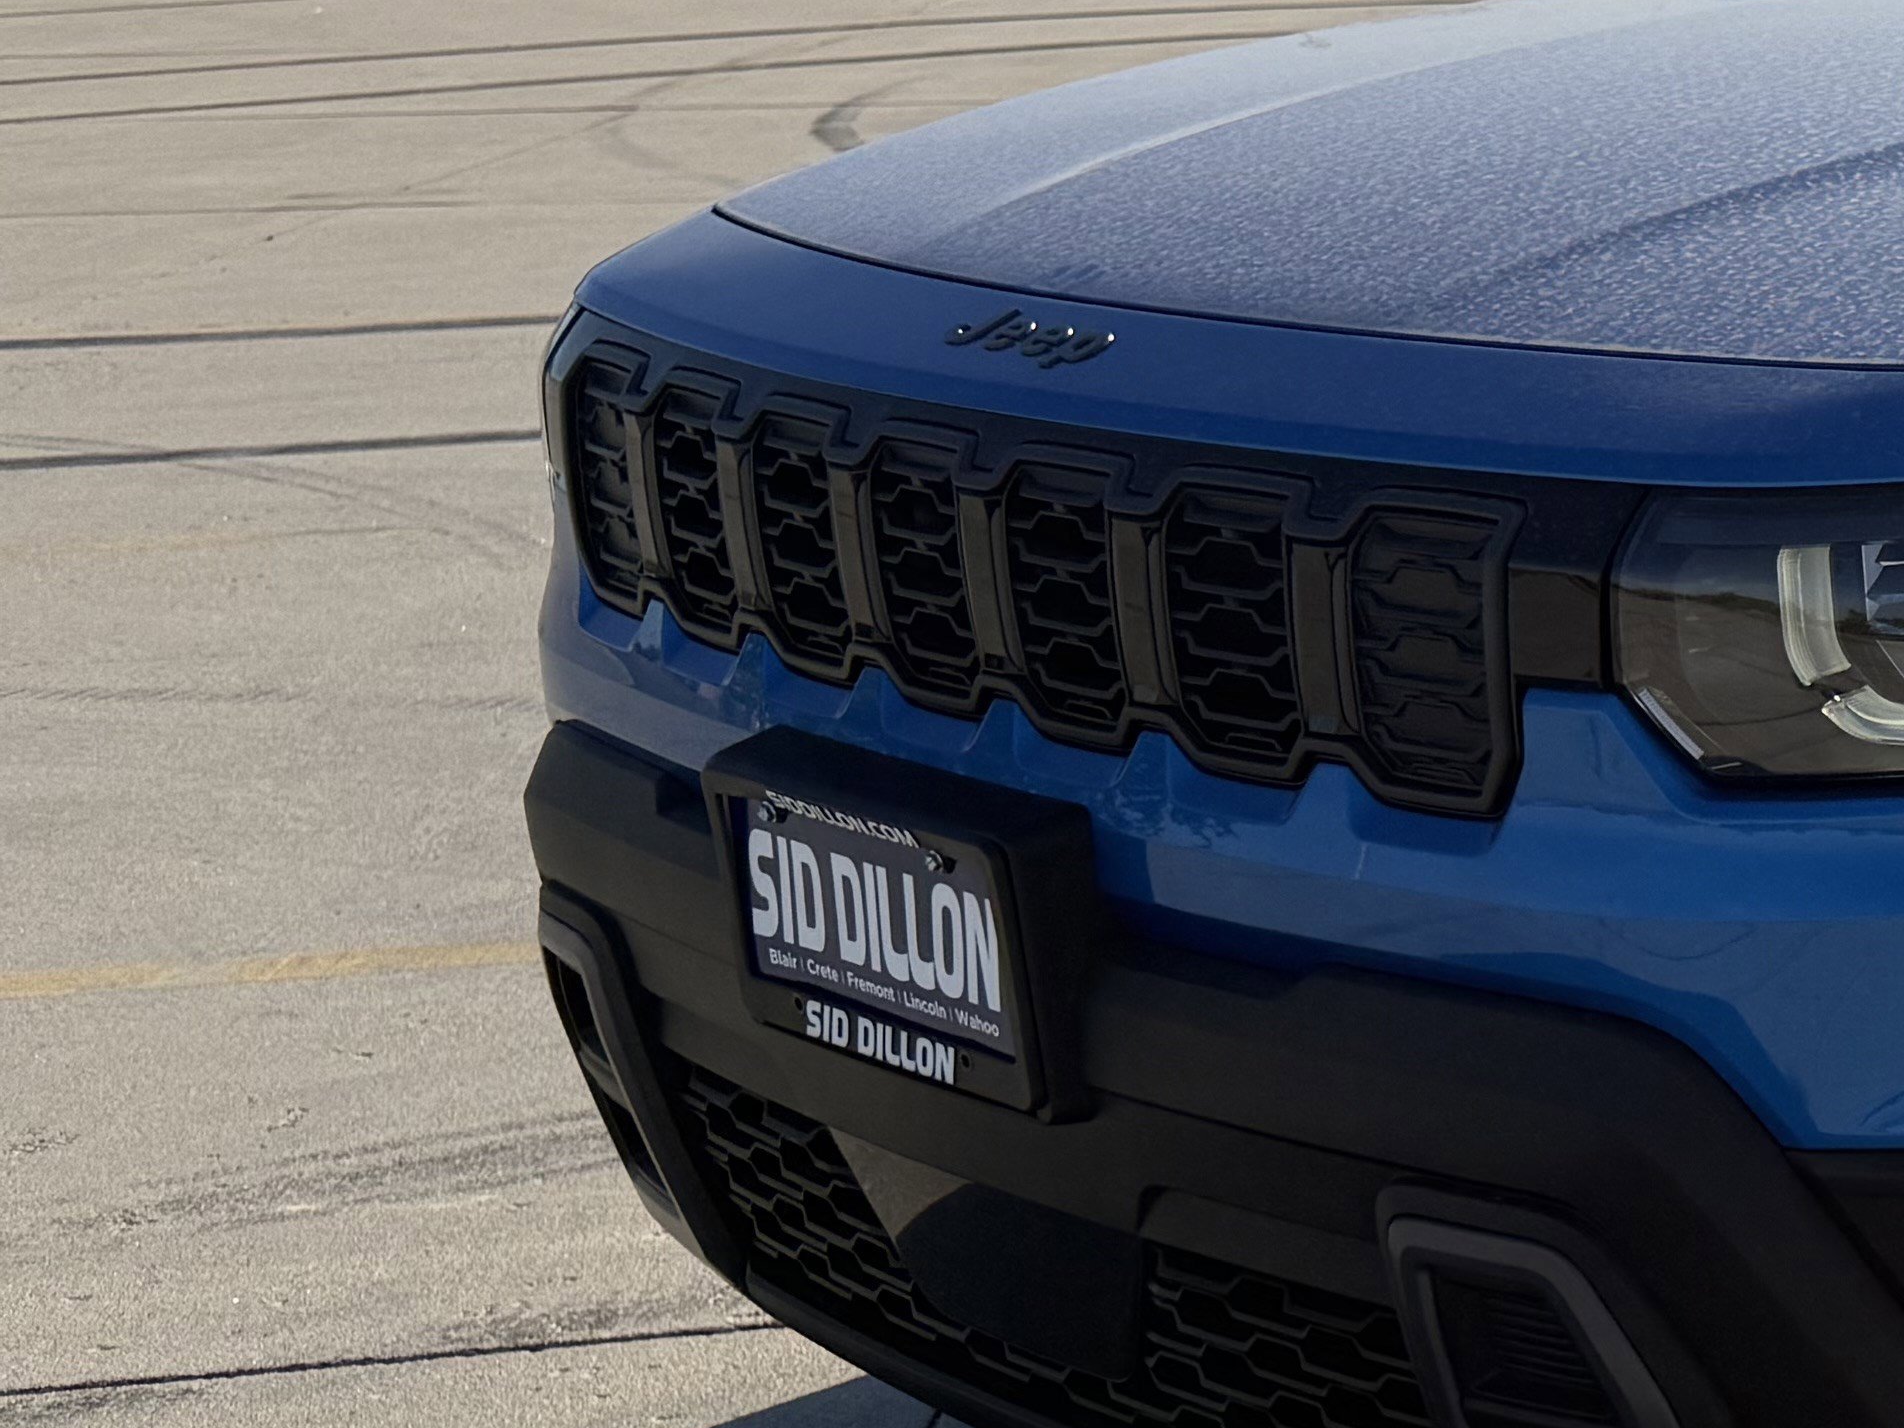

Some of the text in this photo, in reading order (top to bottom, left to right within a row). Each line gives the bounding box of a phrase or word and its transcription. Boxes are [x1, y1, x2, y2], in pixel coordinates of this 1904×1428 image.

[944, 308, 1115, 369] Jeep
[765, 789, 920, 849] SIDDILLON.COM
[748, 828, 1001, 1013] SID DILLON
[769, 947, 1000, 1038] Blair Crete Fremont Lincoln Wahoo
[805, 999, 956, 1086] SID DILLON
